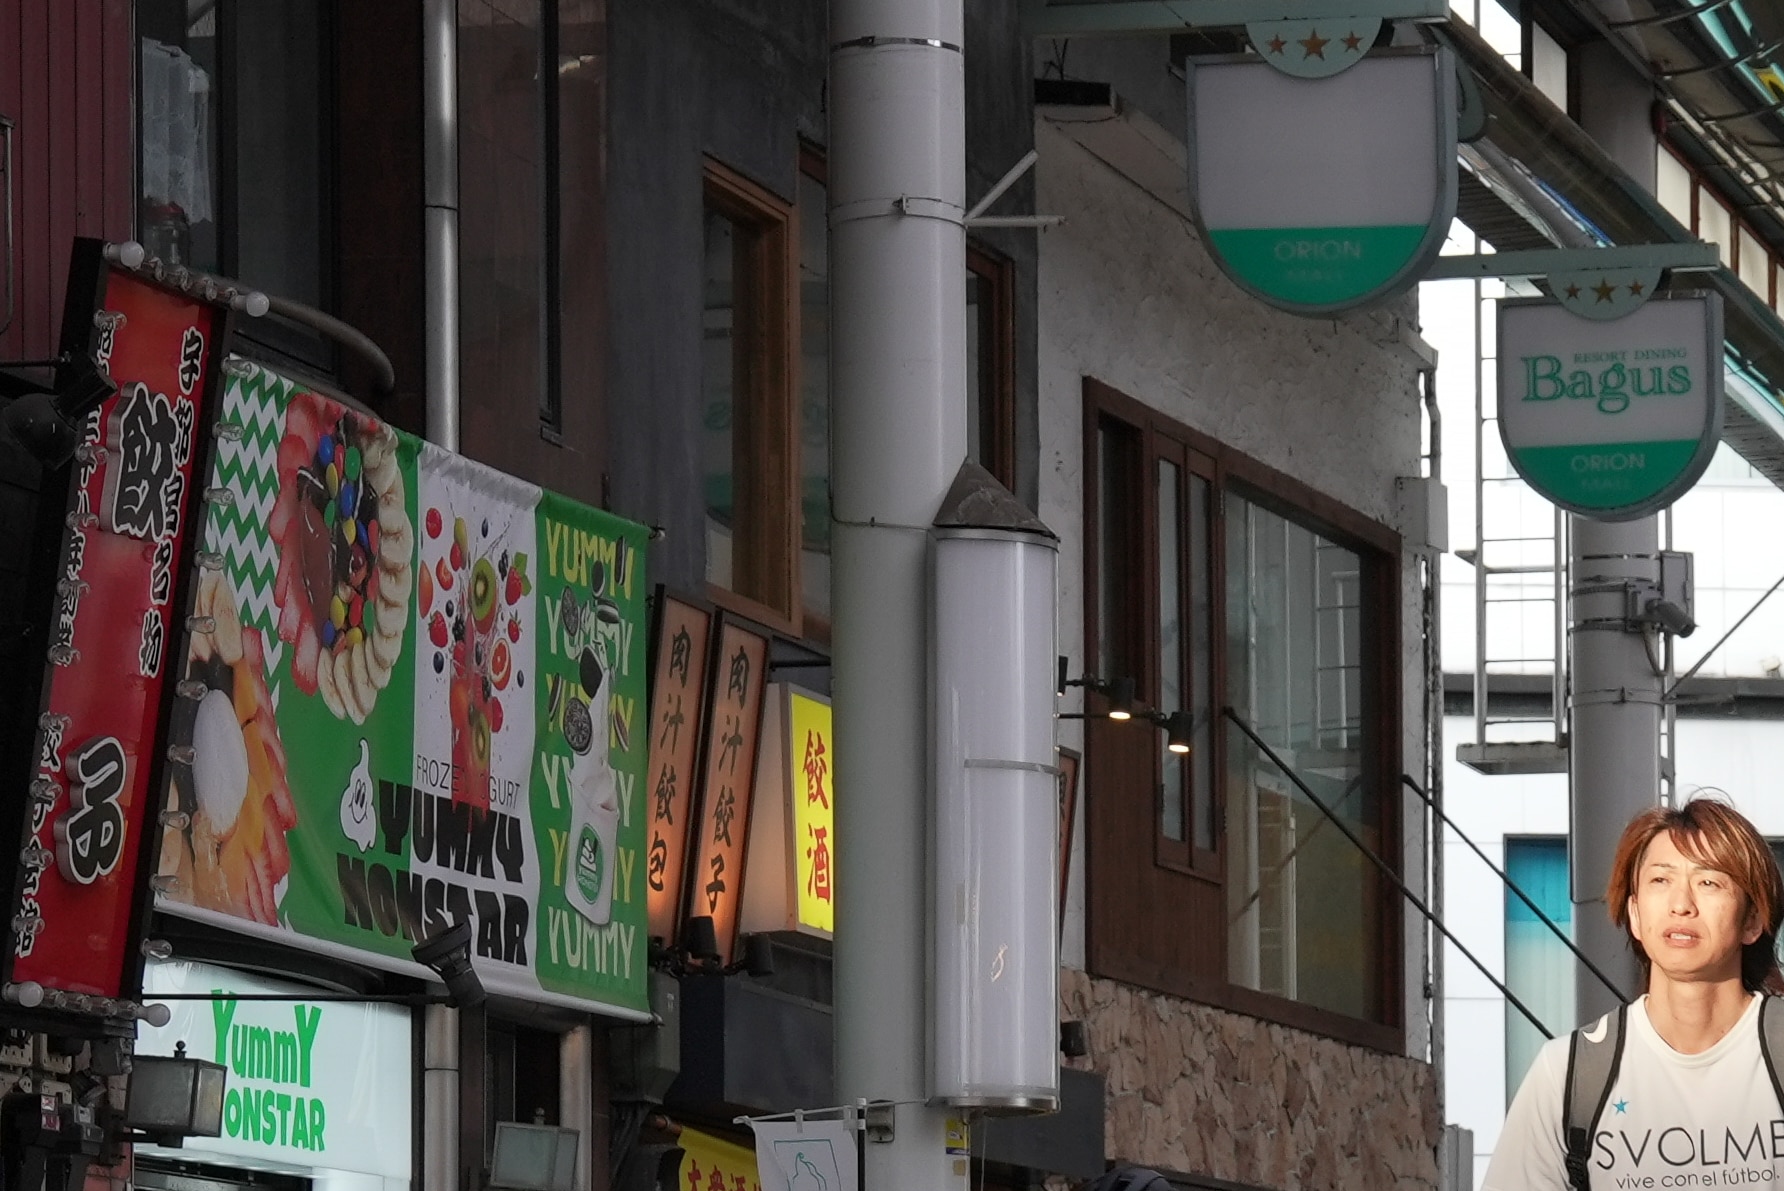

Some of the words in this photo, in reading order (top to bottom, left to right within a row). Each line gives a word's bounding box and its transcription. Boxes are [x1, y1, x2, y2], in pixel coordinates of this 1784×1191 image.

[1274, 240, 1361, 262] ORION
[1520, 354, 1692, 415] Bagus
[1574, 350, 1627, 364] RESORT
[1634, 347, 1688, 360] DINING
[1571, 453, 1647, 473] ORION
[705, 645, 750, 914] 肉汁餃子
[379, 778, 525, 885] YUMMY
[336, 852, 530, 967] MONSTAR
[548, 906, 636, 980] YUMMY
[224, 1086, 326, 1152] ONSTAR
[1615, 1175, 1655, 1190] vive
[1661, 1171, 1699, 1187] con
[1701, 1169, 1717, 1186] el
